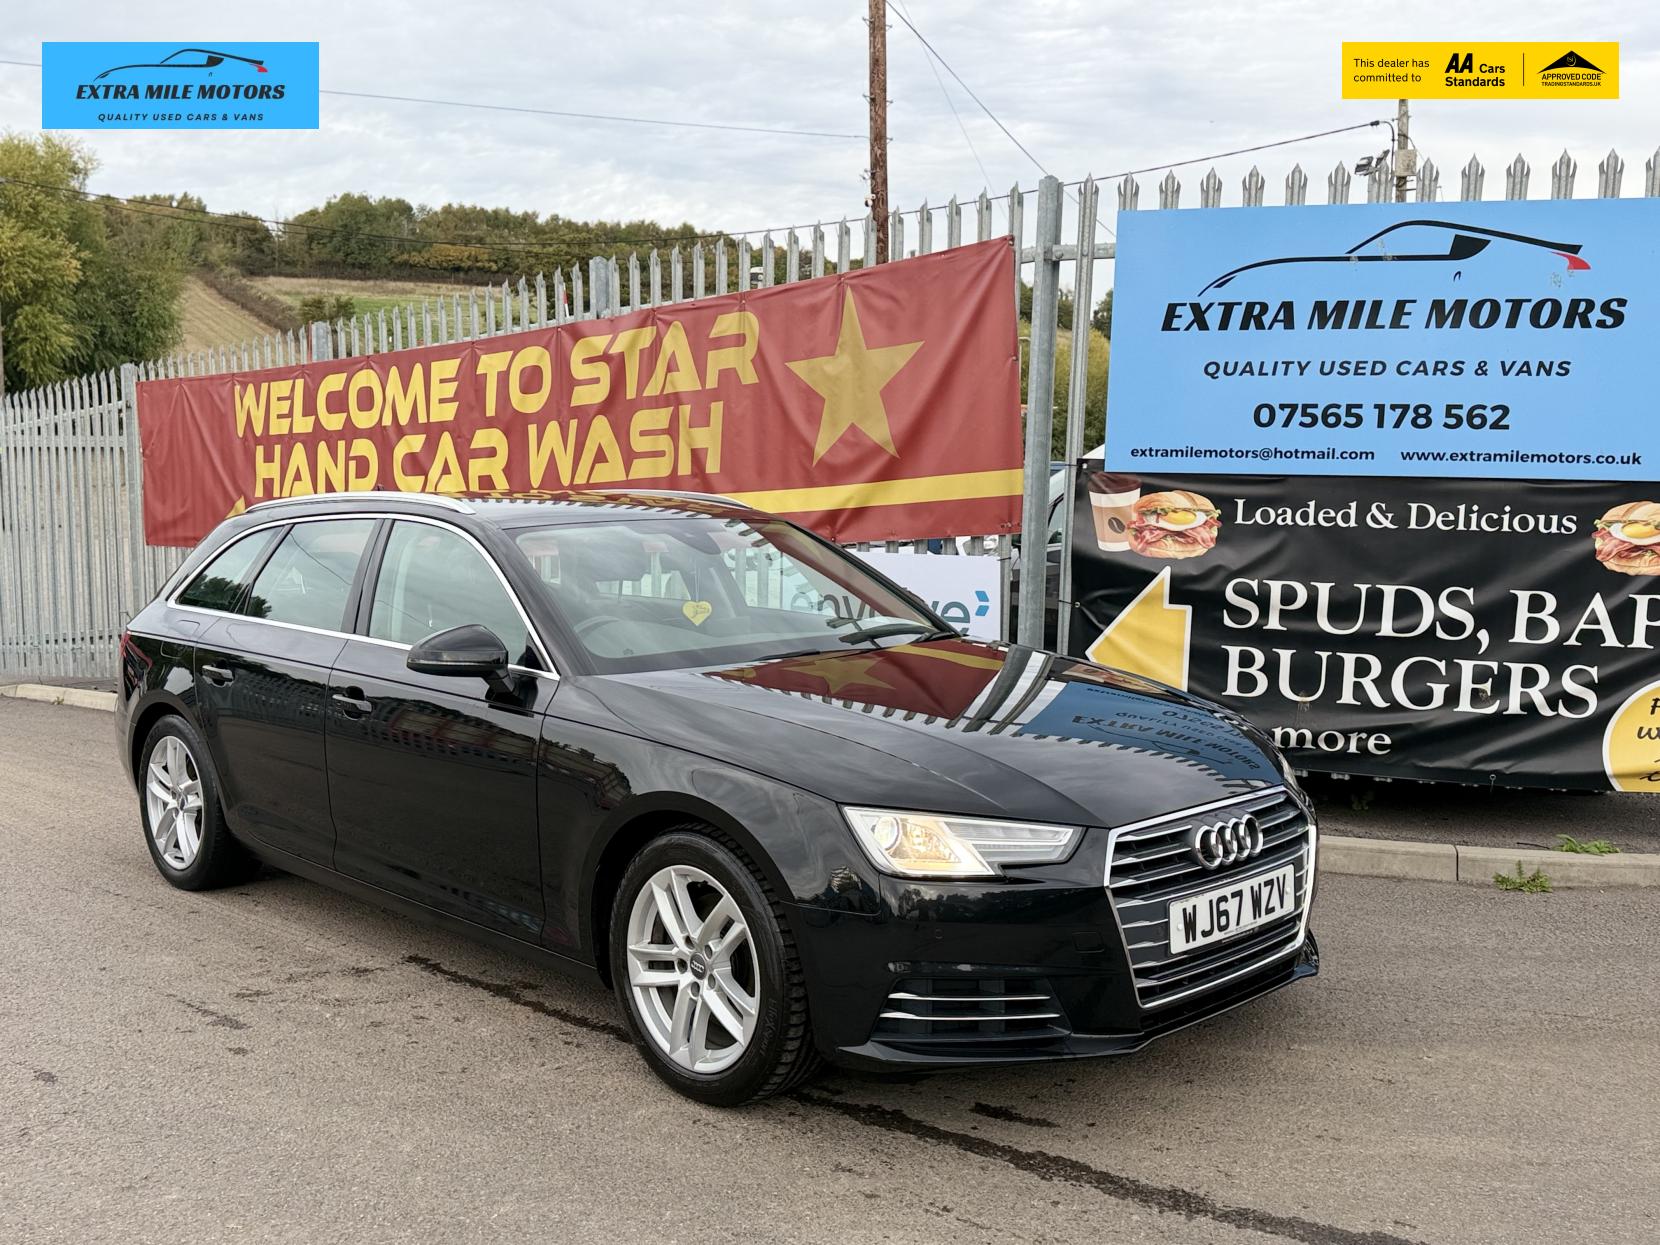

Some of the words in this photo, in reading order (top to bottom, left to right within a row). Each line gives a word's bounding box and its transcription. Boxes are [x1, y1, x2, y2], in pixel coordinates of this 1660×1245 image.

[1161, 300, 1296, 332] EXTRA
[1307, 299, 1417, 330] MILE
[1425, 297, 1629, 330] MOTORS
[234, 357, 462, 438] WELCOME
[475, 345, 552, 417] TO
[570, 310, 760, 408] STAR
[1203, 360, 1312, 380] QUALITY
[1318, 360, 1387, 377] USED
[1395, 360, 1466, 377] CARS
[1473, 360, 1489, 377] &
[1500, 360, 1572, 377] VANS
[1253, 403, 1364, 429] 07565
[1374, 403, 1433, 430] 178
[1442, 403, 1511, 431] 562
[255, 438, 379, 498] HAND
[393, 427, 510, 493] CAR
[527, 400, 724, 489] WASH
[1130, 445, 1375, 461] extramilemotors@hotmail.com
[1400, 449, 1643, 466] www.extramilemotors.co.uk
[1234, 498, 1359, 528] Loaded
[1365, 501, 1399, 530] &
[1407, 502, 1578, 535] Delicious
[1223, 577, 1490, 655] SPUDS,
[1221, 644, 1599, 719] BURGERS
[1271, 723, 1392, 755] more
[1182, 888, 1244, 944] WJ67
[1250, 873, 1287, 921] WZV
